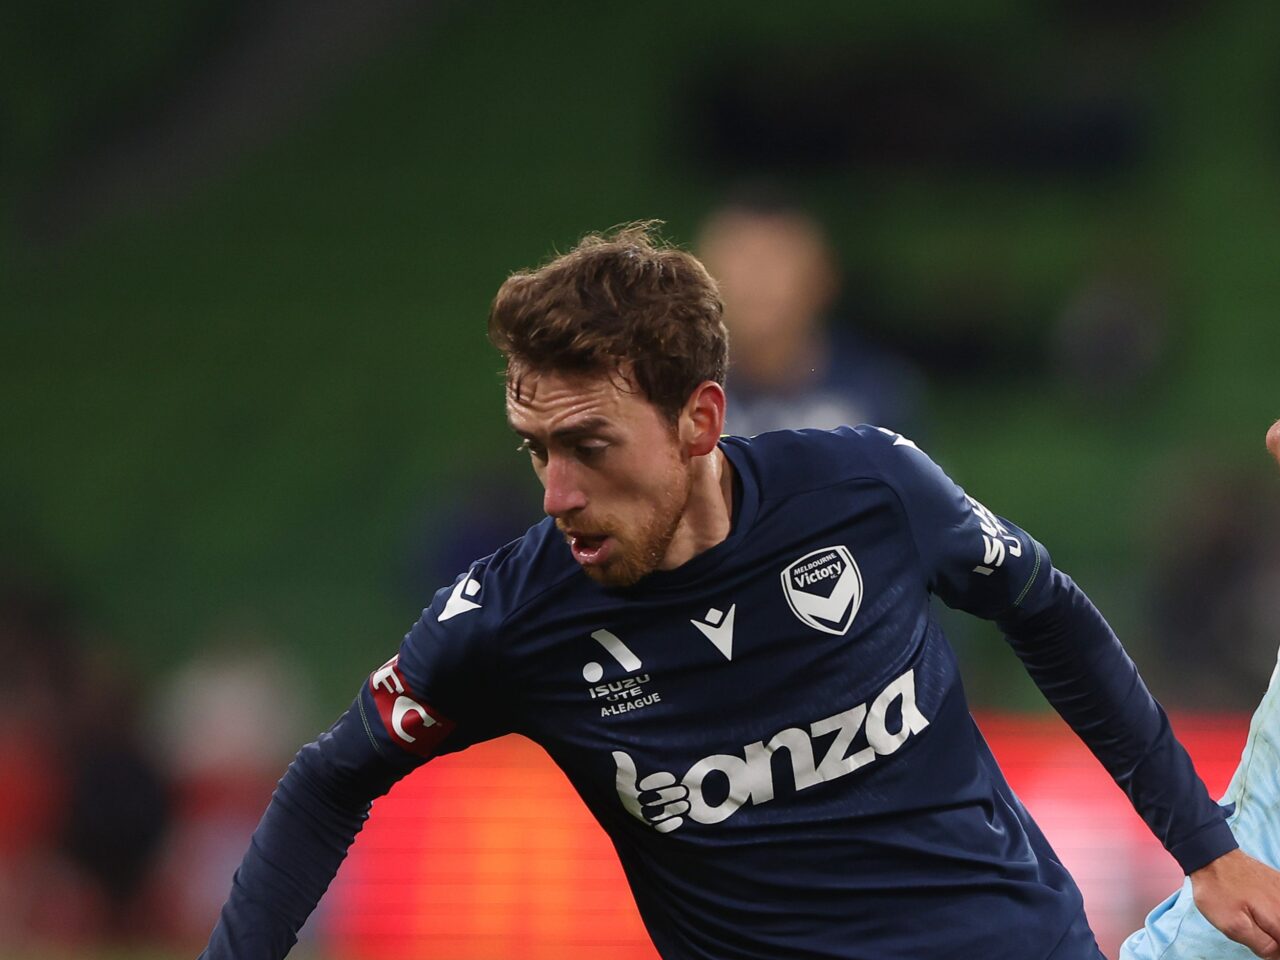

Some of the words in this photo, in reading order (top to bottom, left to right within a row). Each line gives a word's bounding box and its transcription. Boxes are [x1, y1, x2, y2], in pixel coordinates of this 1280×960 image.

[793, 552, 838, 576] MELBOURNE
[793, 561, 842, 588] Victory
[373, 654, 437, 744] FC
[588, 673, 651, 699] ISUZU
[606, 686, 643, 702] UTE
[601, 692, 661, 717] A-LEAGUE
[612, 669, 930, 833] bonza
